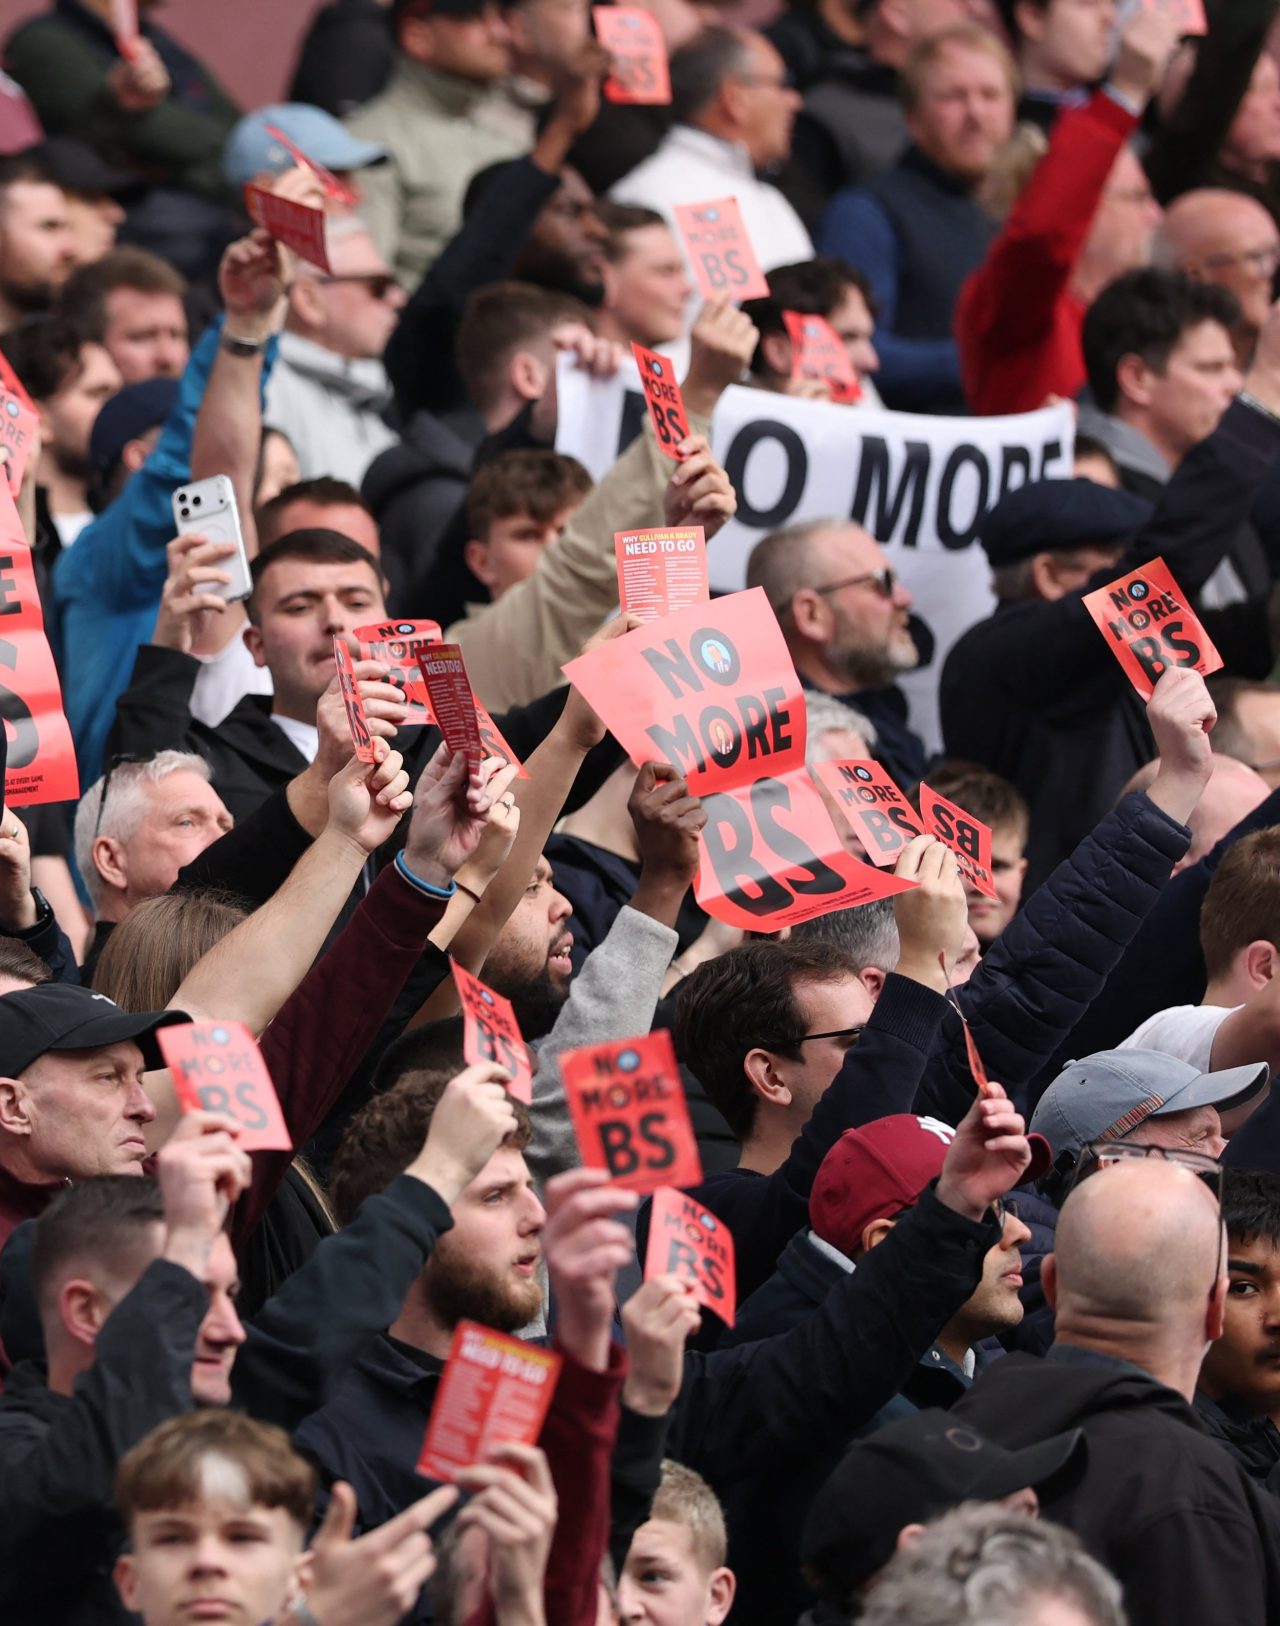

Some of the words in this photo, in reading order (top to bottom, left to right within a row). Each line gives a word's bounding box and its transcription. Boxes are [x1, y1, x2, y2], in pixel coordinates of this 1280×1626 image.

[692, 208, 719, 223] NO
[700, 250, 749, 289] BS
[643, 354, 663, 378] NO
[641, 373, 678, 404] MORE
[651, 400, 686, 446] BS
[622, 535, 638, 544] WHY
[625, 541, 657, 555] NEED
[659, 540, 675, 552] TO
[677, 539, 695, 552] GO
[1109, 579, 1149, 612] NO
[378, 623, 415, 637] NO
[1108, 590, 1181, 641] MORE
[425, 660, 446, 675] NEED
[640, 627, 741, 699] NO
[1129, 621, 1200, 687] BS
[644, 686, 793, 779] MORE
[837, 765, 872, 783] NO
[838, 785, 901, 807] MORE
[699, 776, 847, 917] BS
[858, 806, 922, 852] BS
[932, 803, 979, 862] BS
[191, 1027, 230, 1046] NO
[593, 1050, 641, 1074] NO
[197, 1082, 268, 1130] BS
[581, 1074, 670, 1114] MORE
[598, 1112, 677, 1177] BS
[683, 1201, 716, 1232] NO
[664, 1211, 727, 1262] MORE
[667, 1239, 724, 1299] BS
